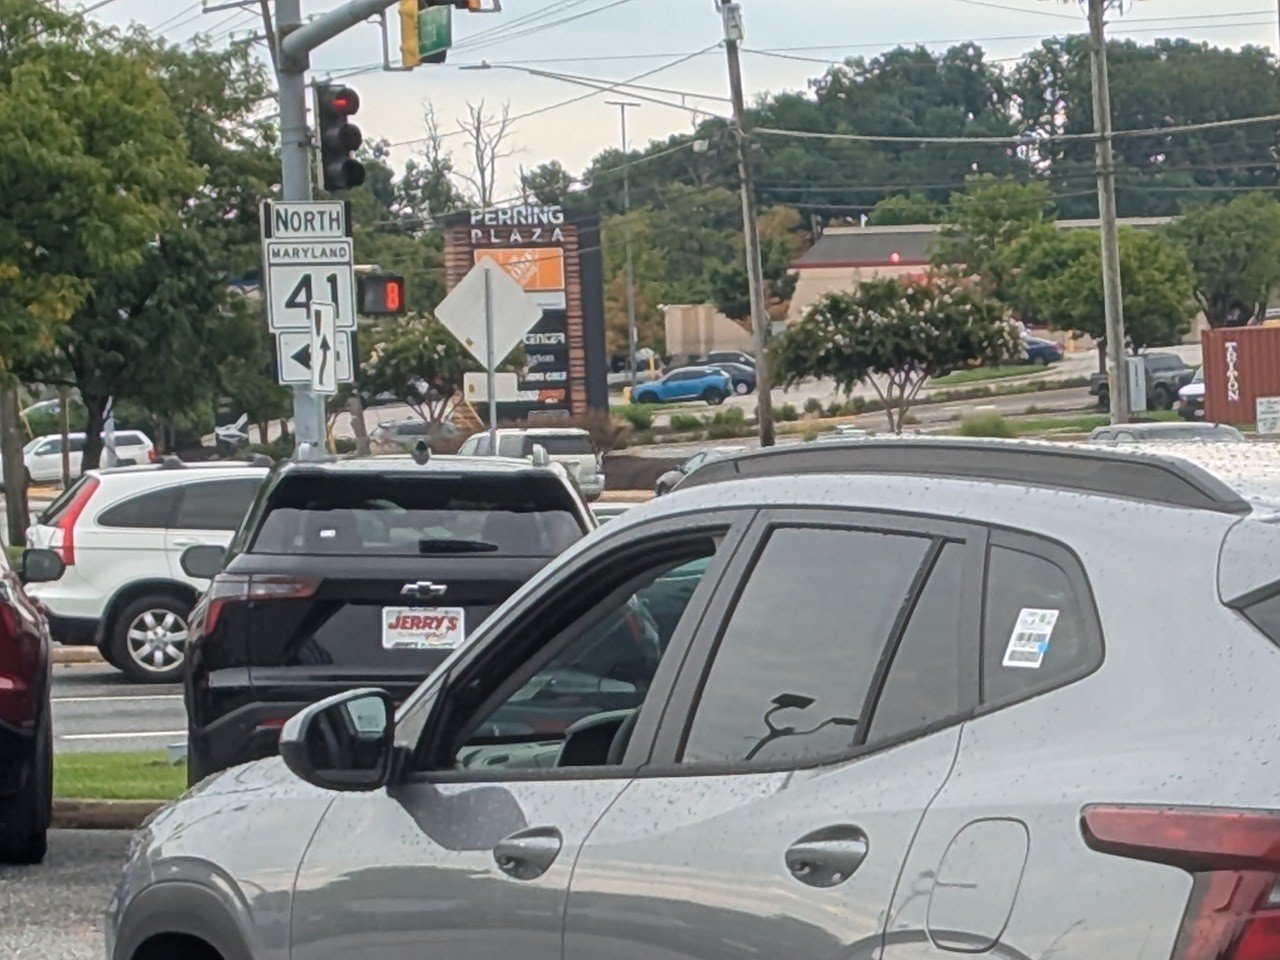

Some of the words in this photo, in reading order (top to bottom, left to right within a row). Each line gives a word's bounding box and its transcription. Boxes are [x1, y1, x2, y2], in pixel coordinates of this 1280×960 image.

[275, 208, 341, 232] NORTH
[470, 205, 565, 225] PERRING
[470, 227, 565, 243] PLAZA
[271, 247, 347, 259] MARYLAND
[284, 273, 340, 320] 41
[388, 615, 459, 631] JERRY'S
